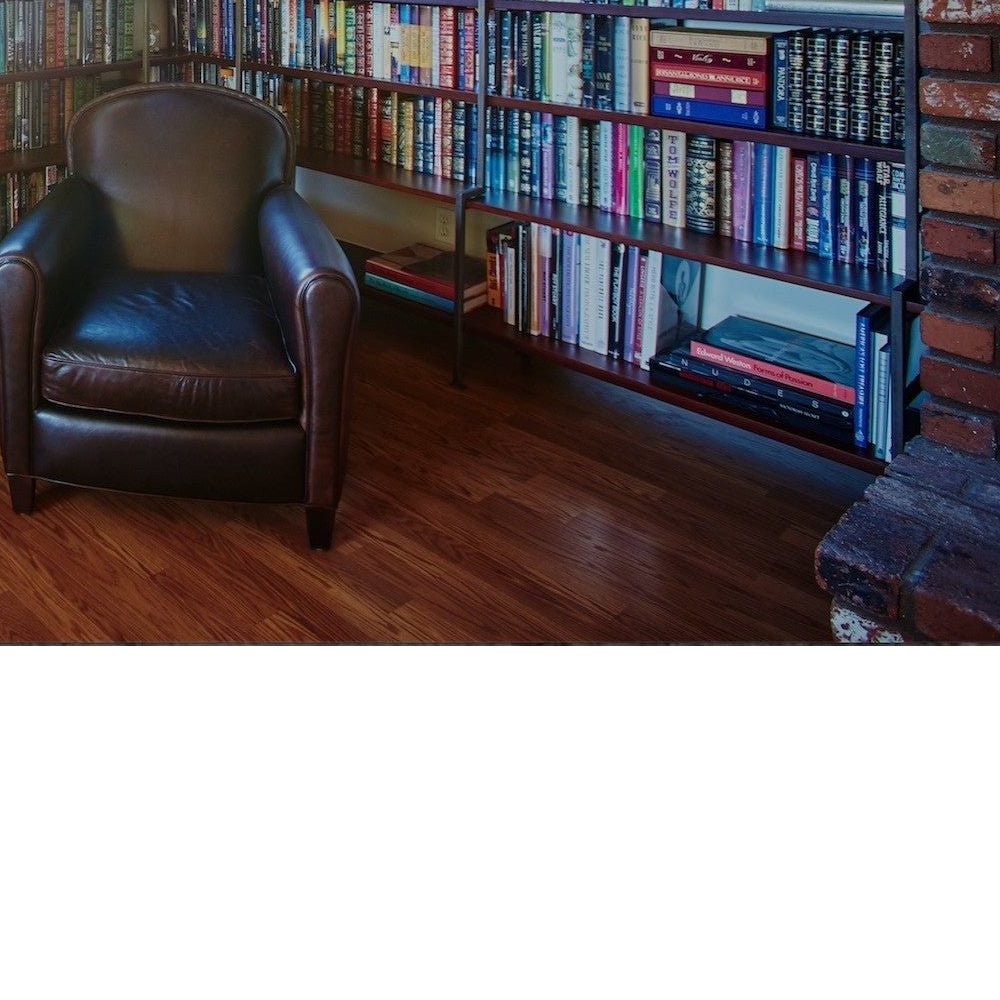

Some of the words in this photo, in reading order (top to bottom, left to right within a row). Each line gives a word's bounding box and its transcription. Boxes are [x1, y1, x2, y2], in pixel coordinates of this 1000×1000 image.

[776, 66, 785, 101] PANDORA
[667, 135, 678, 164] TOM
[667, 169, 678, 220] WOLFE
[878, 195, 887, 234] ALLEGIANCE
[696, 347, 723, 361] Edward
[724, 355, 751, 370] Weston
[753, 364, 773, 376] Forms
[774, 370, 783, 379] of
[784, 372, 813, 388] Passion
